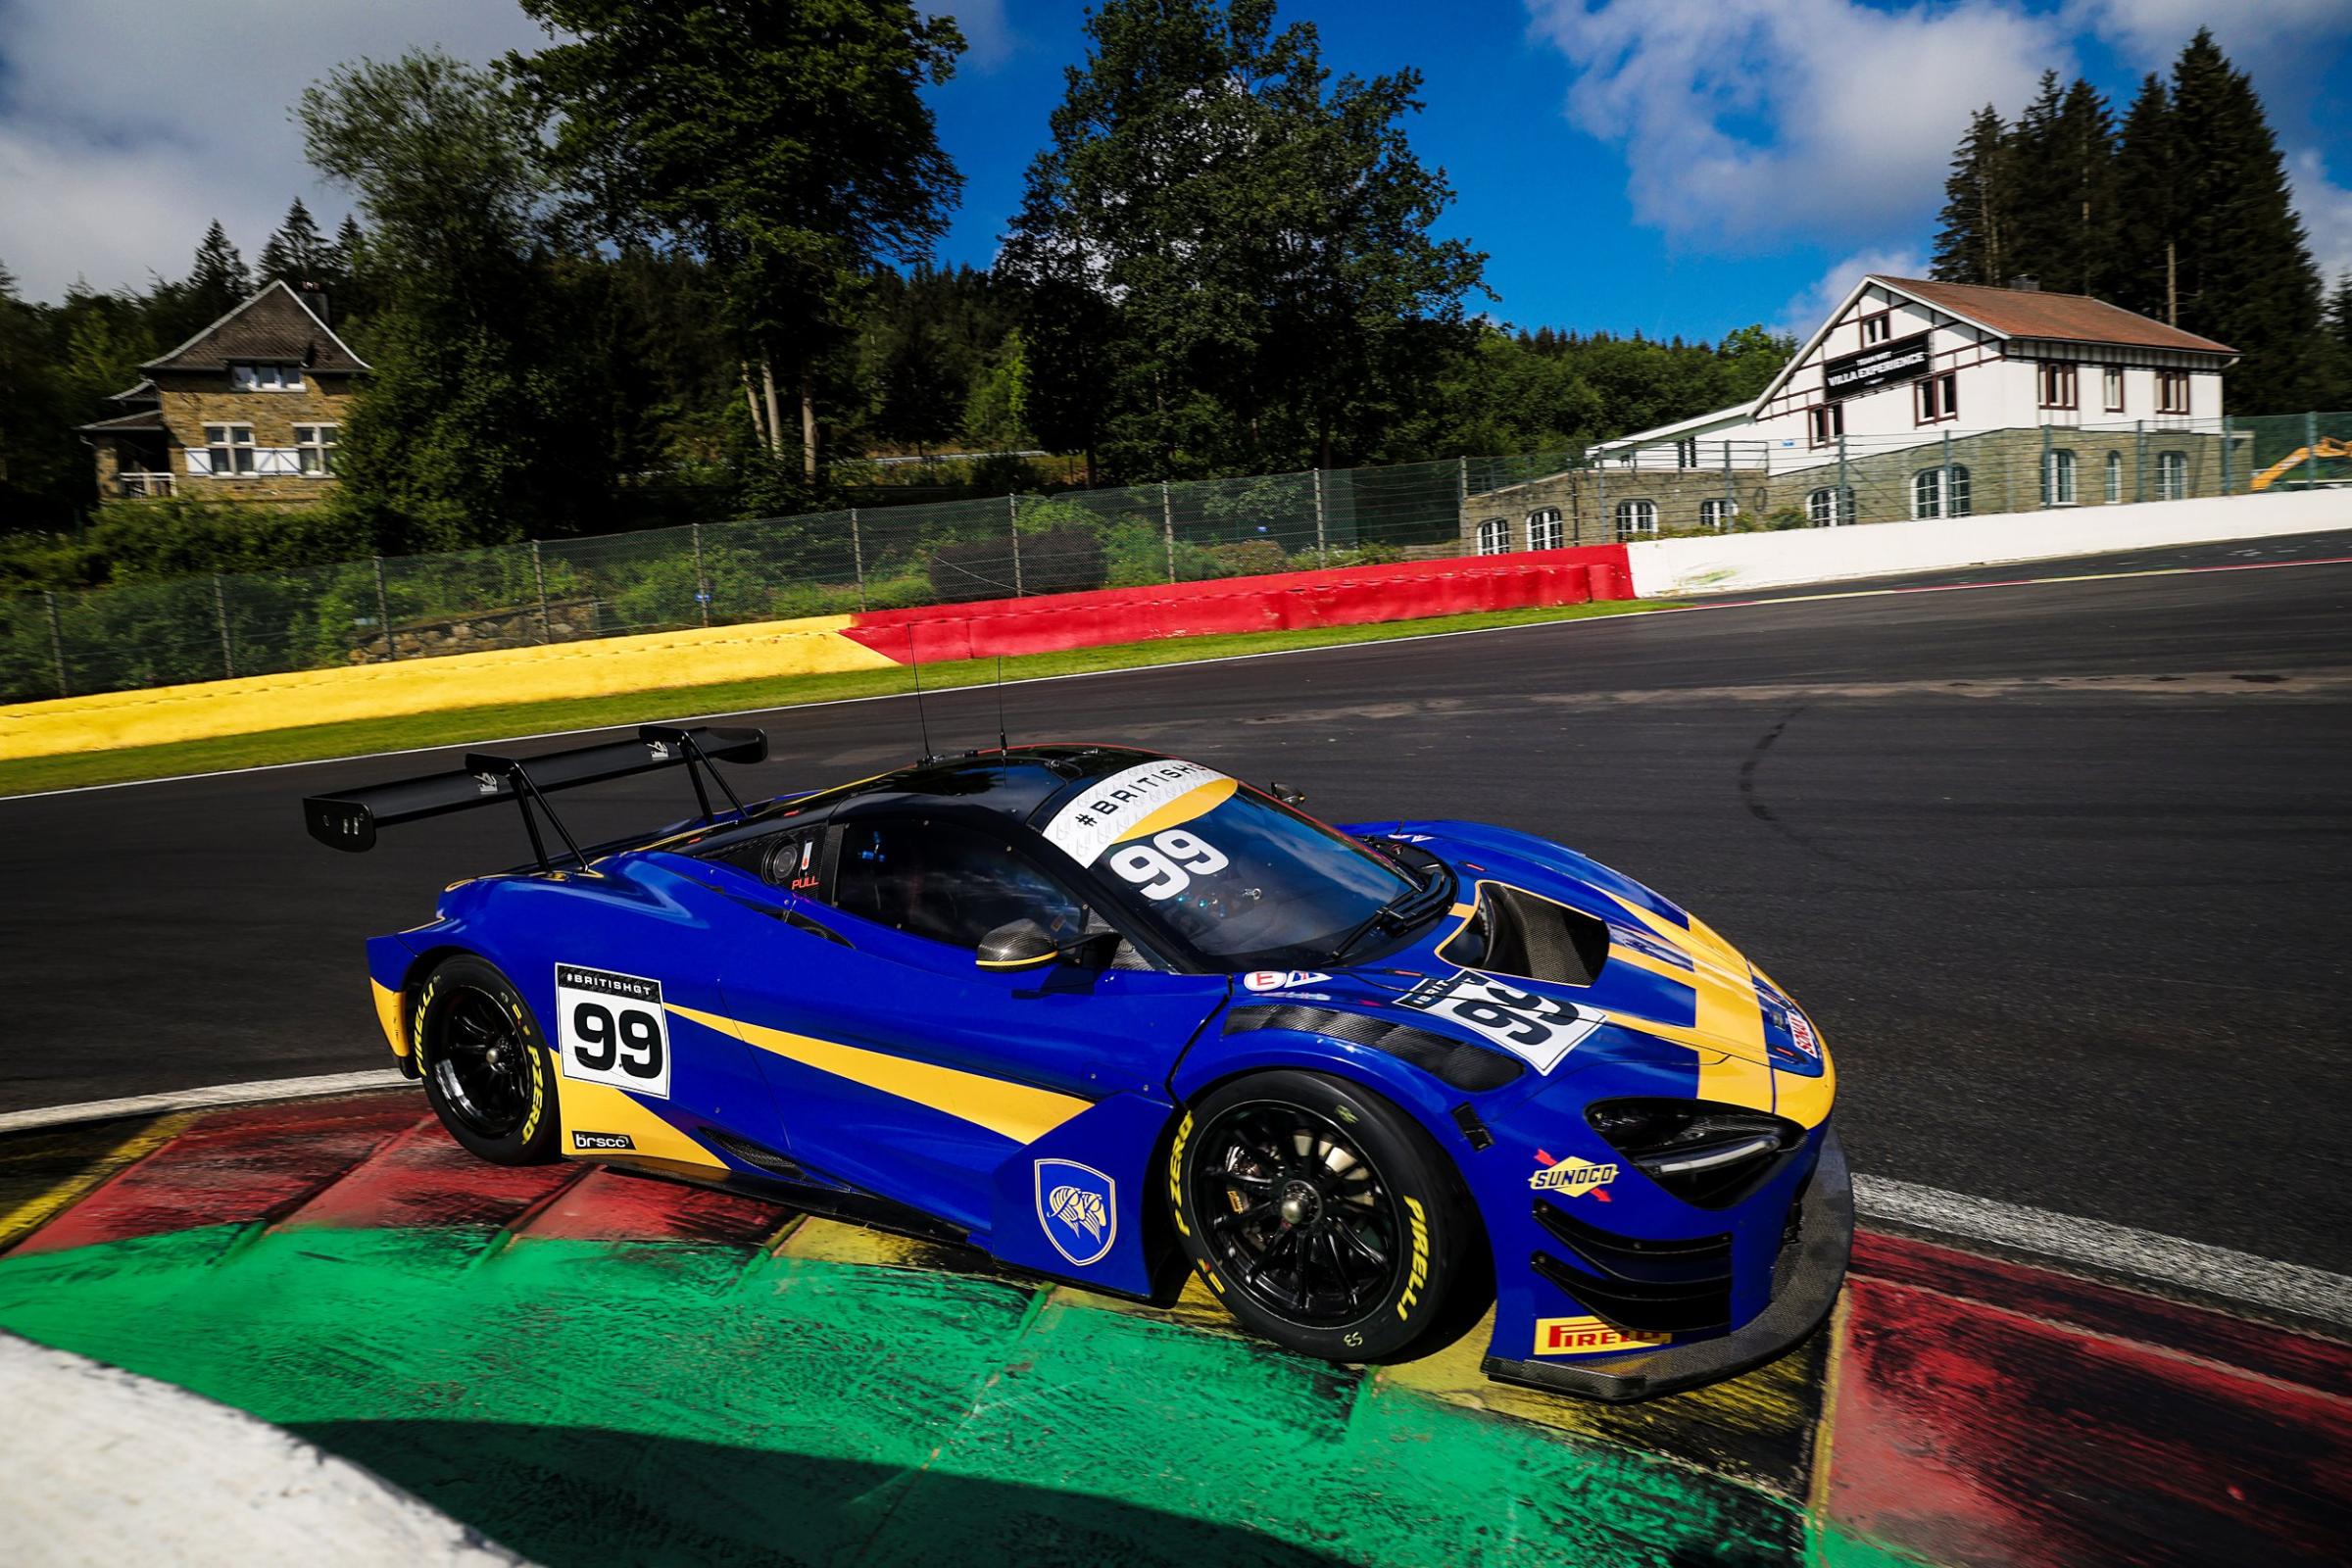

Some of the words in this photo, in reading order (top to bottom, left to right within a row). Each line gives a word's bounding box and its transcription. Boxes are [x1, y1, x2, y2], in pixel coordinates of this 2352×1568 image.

[1827, 370, 1858, 387] VILLA
[1857, 351, 1926, 378] EXPERIENCE
[791, 875, 819, 890] PULL
[1109, 829, 1229, 901] 99
[566, 973, 652, 997] #BRITISHGT
[414, 982, 434, 1076] PIRELLI
[573, 1002, 663, 1079] 99
[575, 1133, 627, 1148] brscc
[1534, 1164, 1616, 1188] SUNOCO
[1397, 1195, 1430, 1321] PIRELLI
